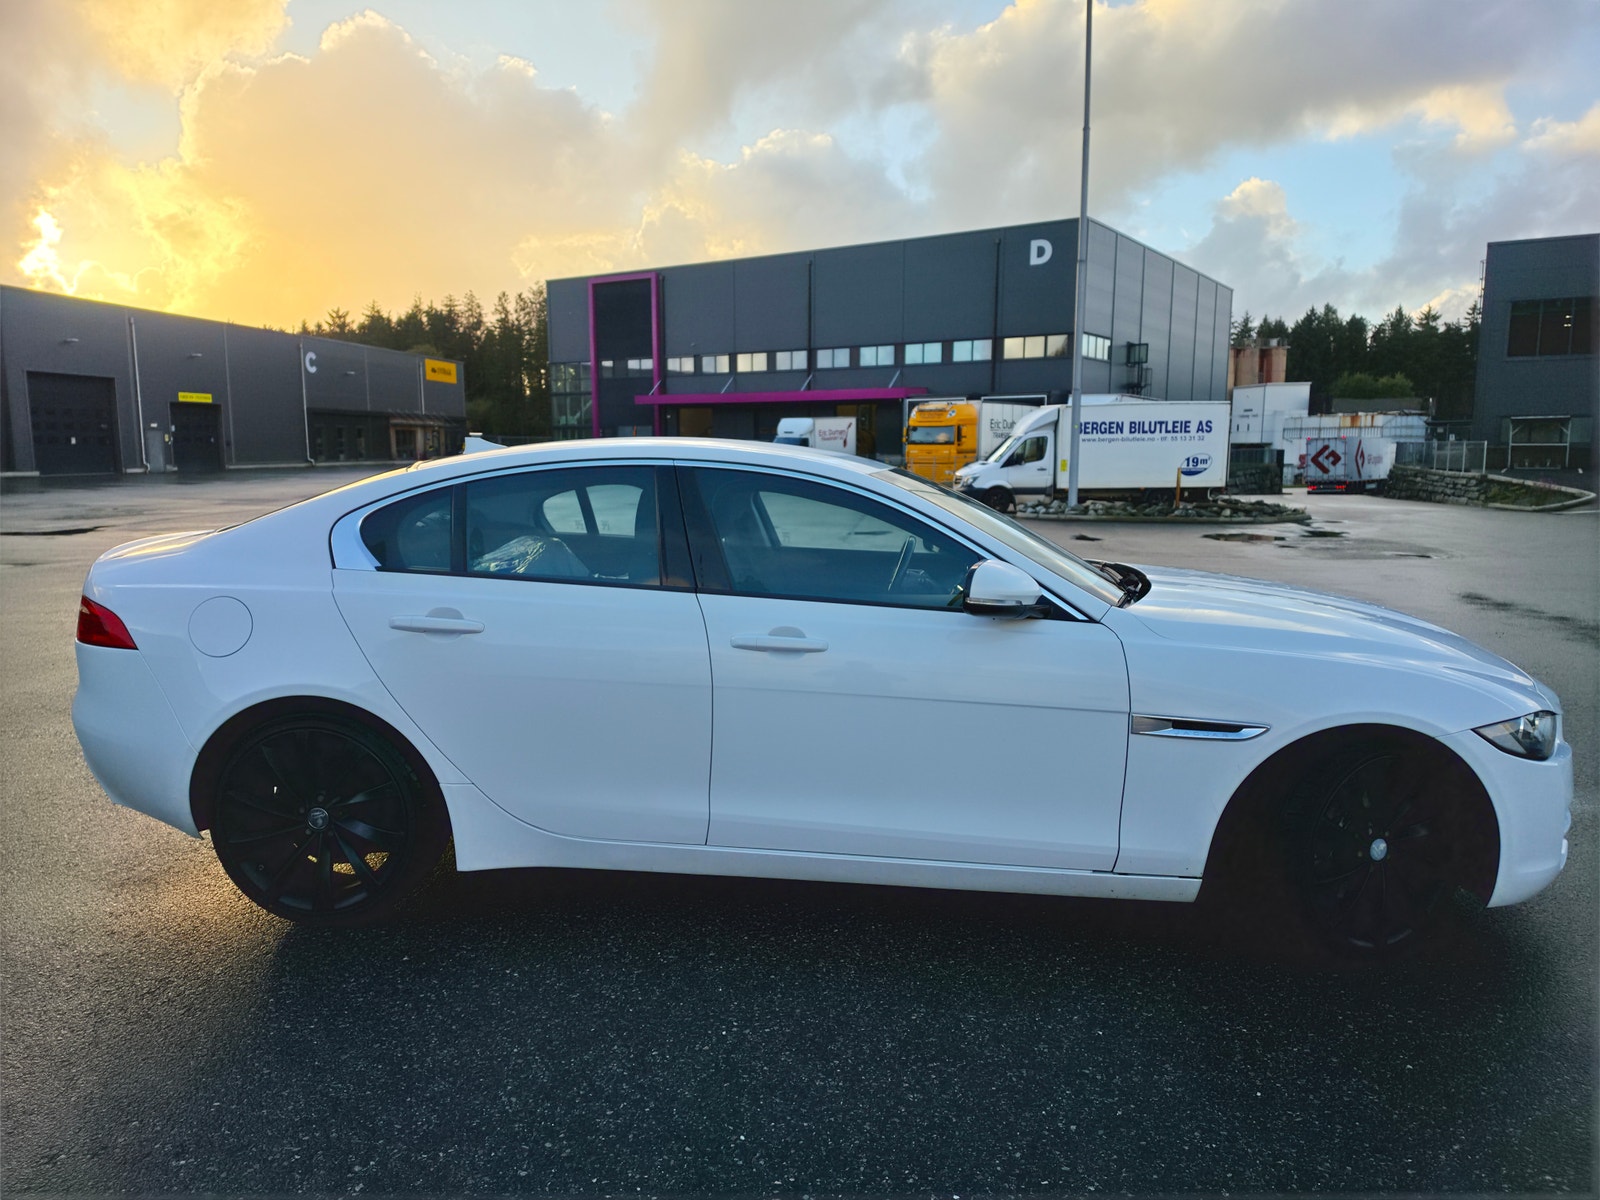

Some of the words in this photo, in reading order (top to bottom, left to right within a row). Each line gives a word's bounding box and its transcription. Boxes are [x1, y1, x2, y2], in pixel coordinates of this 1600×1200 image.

[1030, 239, 1053, 266] D
[305, 351, 317, 374] C
[1129, 420, 1191, 435] BILUTLEIE
[1196, 419, 1213, 434] AS
